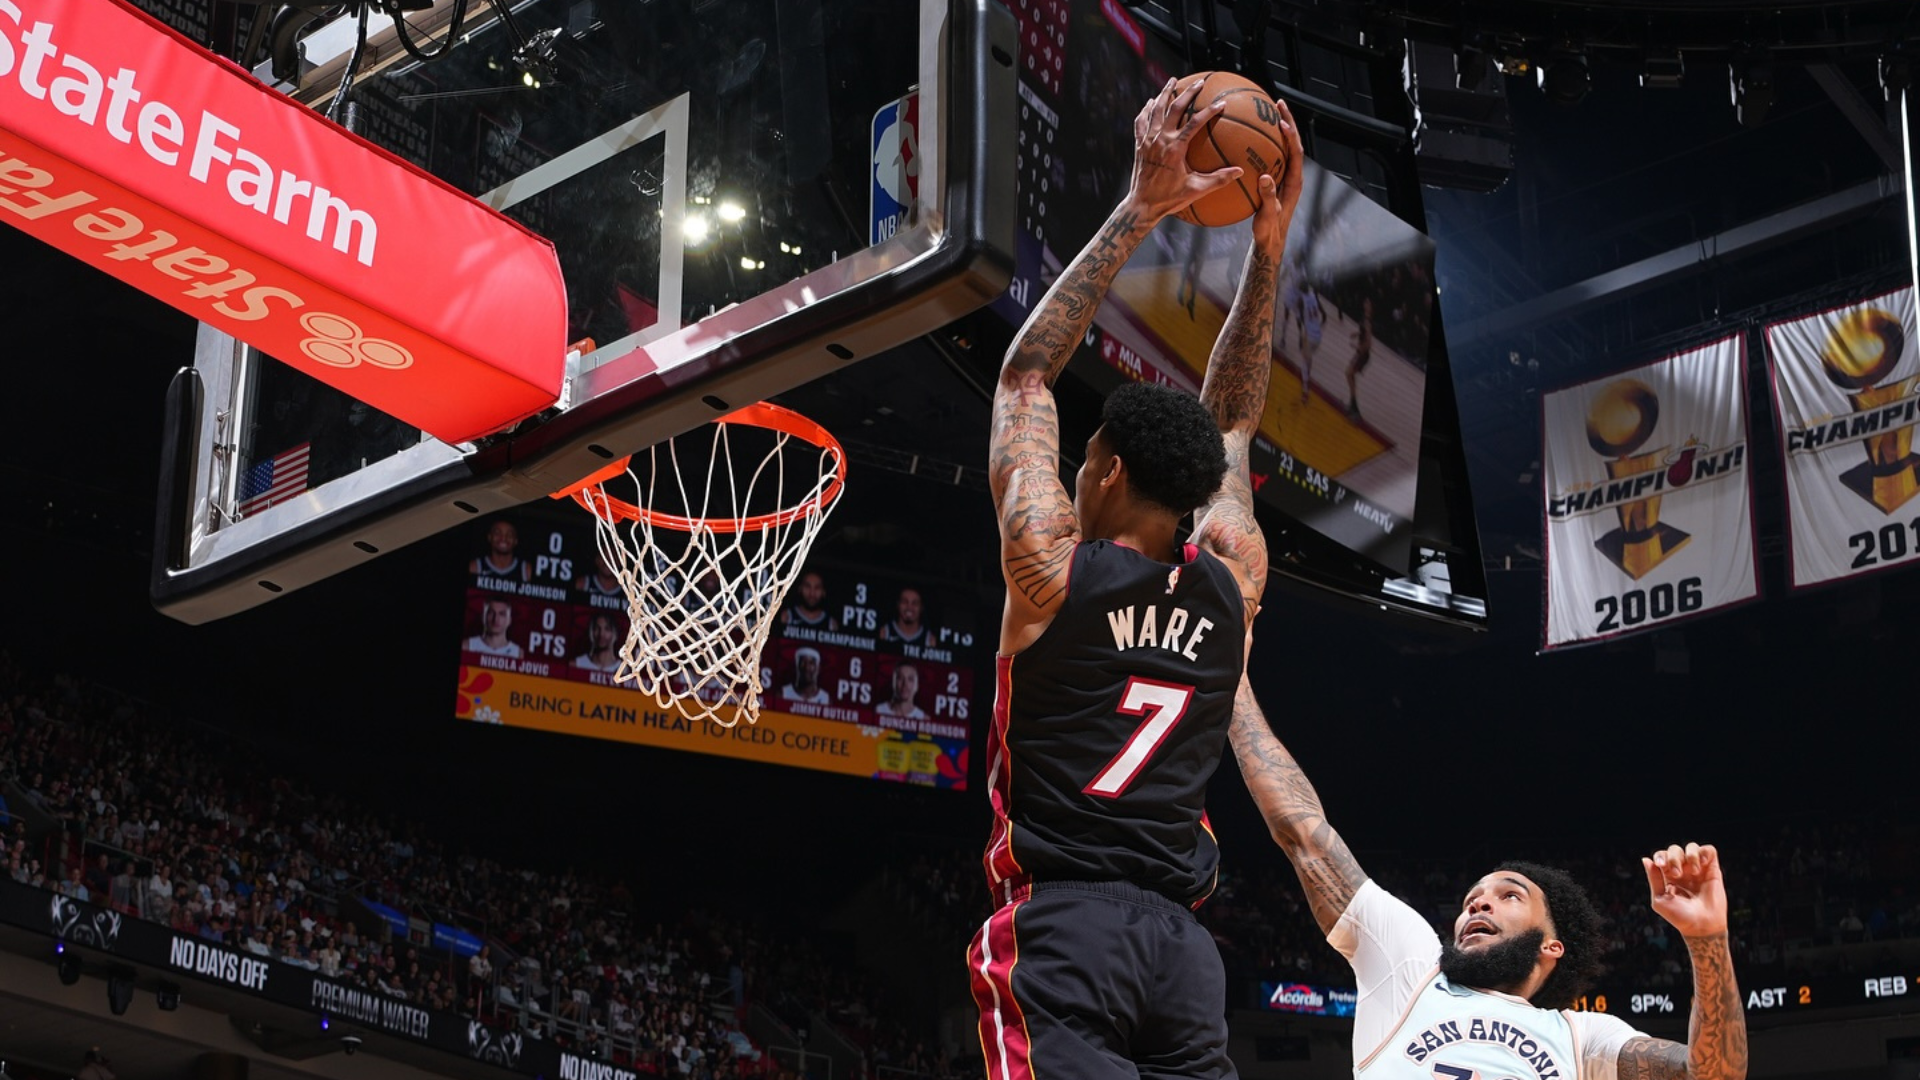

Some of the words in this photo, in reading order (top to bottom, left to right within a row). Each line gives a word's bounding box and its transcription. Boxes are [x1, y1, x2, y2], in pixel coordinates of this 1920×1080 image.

[1033, 7, 1040, 23] 0
[1057, 32, 1065, 48] 0
[1060, 9, 1067, 24] 0
[1028, 54, 1035, 70] 0
[1030, 31, 1037, 47] 0
[1055, 56, 1062, 71] 0
[1046, 129, 1053, 144] 0
[1044, 153, 1051, 168] 0
[1041, 177, 1048, 193] 0
[1039, 202, 1046, 217] 0
[1036, 226, 1043, 241] 0
[1118, 345, 1142, 375] MIA
[1788, 399, 1918, 451] CHAMPI
[1280, 451, 1294, 473] 23
[1305, 467, 1330, 493] SAS
[548, 531, 564, 556] 0
[535, 555, 573, 582] PTS
[476, 575, 517, 594] KELDON
[517, 582, 567, 602] JOHNSON
[855, 582, 868, 606] 3
[841, 604, 877, 631] PTS
[1594, 576, 1703, 633] 2006
[541, 607, 557, 631] 0
[528, 631, 567, 658] PTS
[783, 625, 817, 642] JULIAN
[817, 628, 877, 651] CHAMPAGNIE
[1107, 604, 1215, 662] WARE
[480, 654, 517, 672] NIKOLA
[518, 659, 550, 677] JOVIC
[903, 643, 921, 658] TRE
[921, 646, 953, 663] JONES
[849, 656, 862, 679] 6
[837, 678, 872, 705] PTS
[946, 671, 959, 694] 2
[789, 701, 823, 718] JIMMY
[823, 704, 859, 722] BUTLER
[934, 694, 970, 720] PTS
[509, 691, 573, 716] BRING
[579, 701, 636, 725] LATIN
[643, 710, 694, 733] HEAT
[702, 719, 726, 738] TO
[732, 725, 776, 745] ICED
[781, 731, 851, 757] COFFEE
[879, 715, 918, 732] DUNCAN
[918, 720, 966, 739] ROBINSON
[1080, 675, 1196, 799] 7
[170, 935, 196, 970] NO
[196, 944, 239, 983] DAYS
[239, 957, 269, 991] OFF
[1270, 983, 1324, 1008] Acordis
[1630, 994, 1675, 1013] 3P%
[1747, 987, 1787, 1010] AST
[1798, 985, 1812, 1004] 2
[1864, 975, 1908, 998] REB
[311, 979, 380, 1025] PREMIUM
[382, 999, 430, 1040] WATER
[1406, 1020, 1464, 1062] SAN
[559, 1052, 580, 1080] NO
